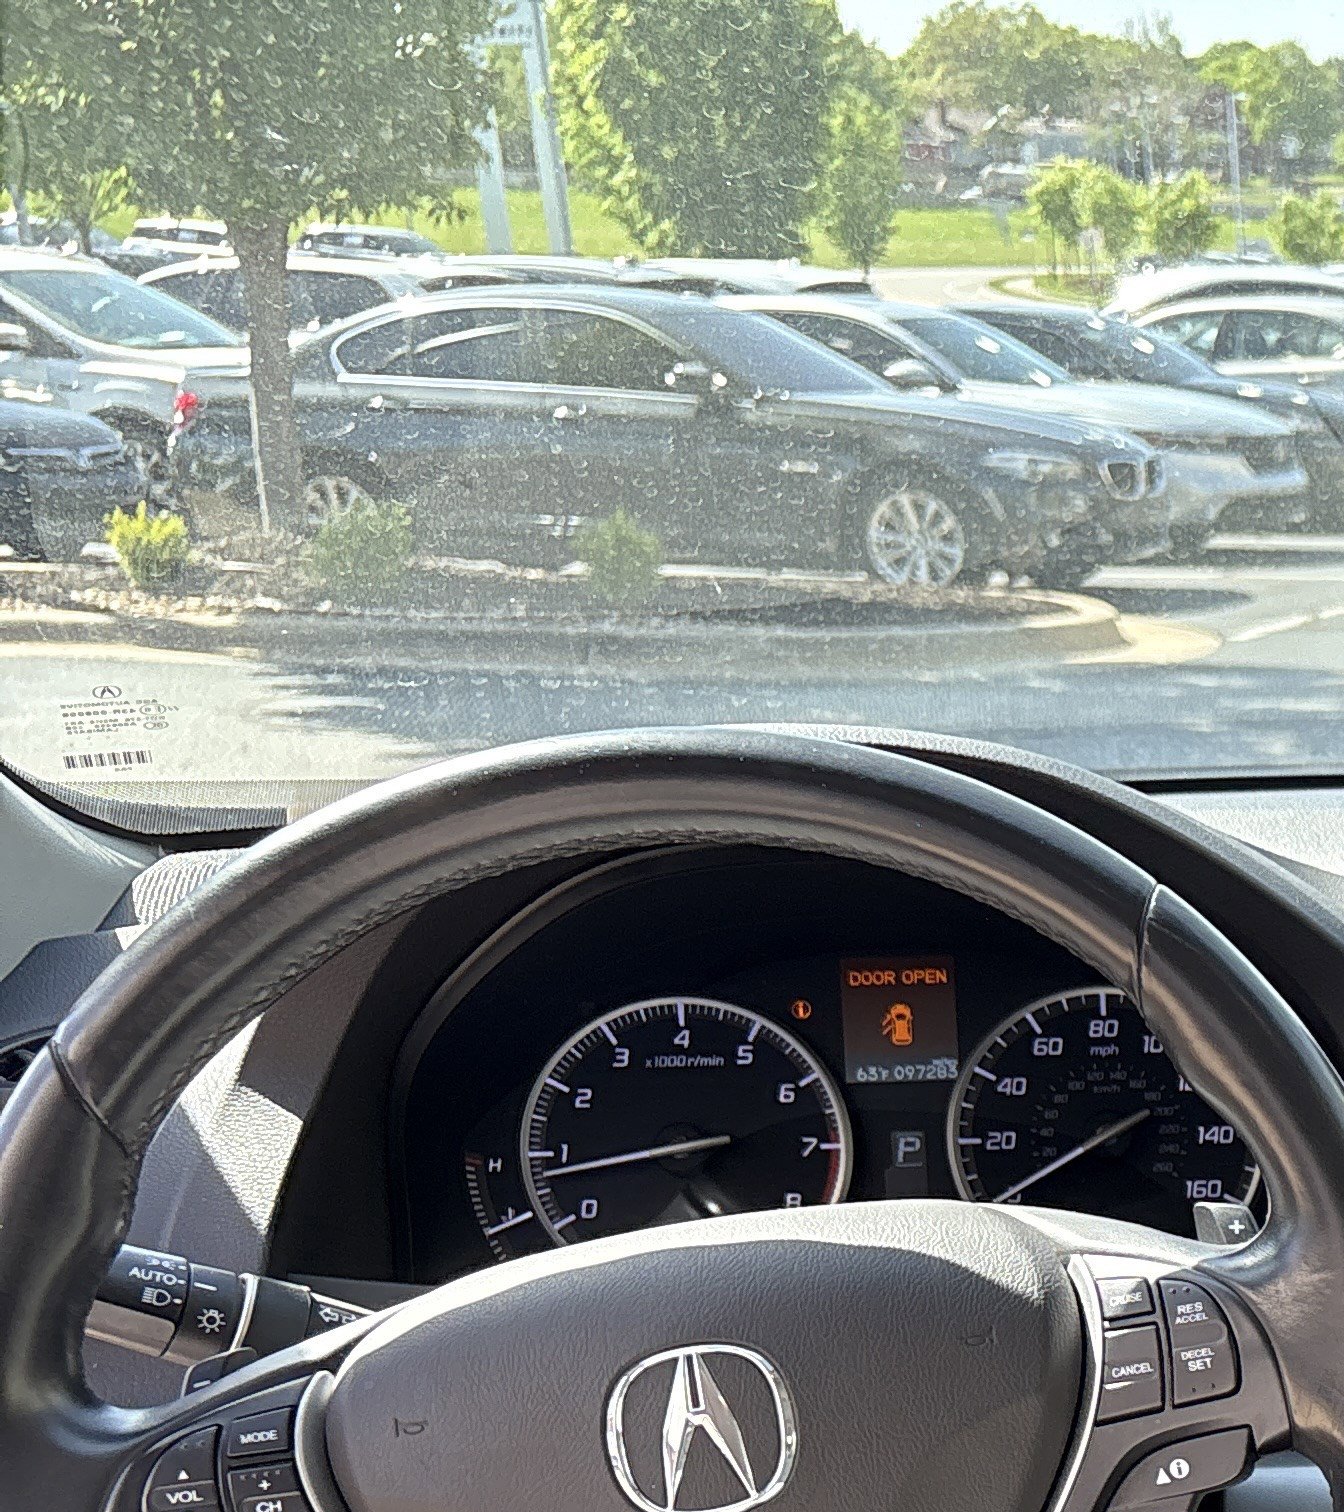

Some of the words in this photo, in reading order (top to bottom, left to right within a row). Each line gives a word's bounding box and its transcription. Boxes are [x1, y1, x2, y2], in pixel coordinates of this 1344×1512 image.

[849, 971, 896, 987] DOOR
[901, 969, 948, 985] OPEN
[1089, 1020, 1119, 1038] 80
[674, 1029, 690, 1049] 4
[1033, 1038, 1063, 1056] 60
[612, 1048, 630, 1067] 3
[737, 1045, 753, 1065] 5
[1090, 1044, 1119, 1057] mph
[779, 1084, 796, 1103] 6
[997, 1077, 1027, 1095] 40
[574, 1088, 592, 1109] 2
[986, 1132, 1016, 1150] 20
[1198, 1126, 1234, 1144] 140
[561, 1144, 569, 1163] 1
[801, 1137, 818, 1157] 7
[898, 1136, 921, 1163] P
[488, 1159, 501, 1172] H
[1186, 1180, 1222, 1199] 160
[581, 1199, 598, 1219] 0
[129, 1266, 178, 1285] AUTO
[1177, 1302, 1203, 1315] RES
[1175, 1313, 1208, 1324] ACCEL
[1181, 1347, 1215, 1360] DECEL
[1111, 1363, 1154, 1378] CANCEL
[1188, 1358, 1212, 1372] SET
[240, 1429, 278, 1444] MODE
[166, 1490, 204, 1504] VOL
